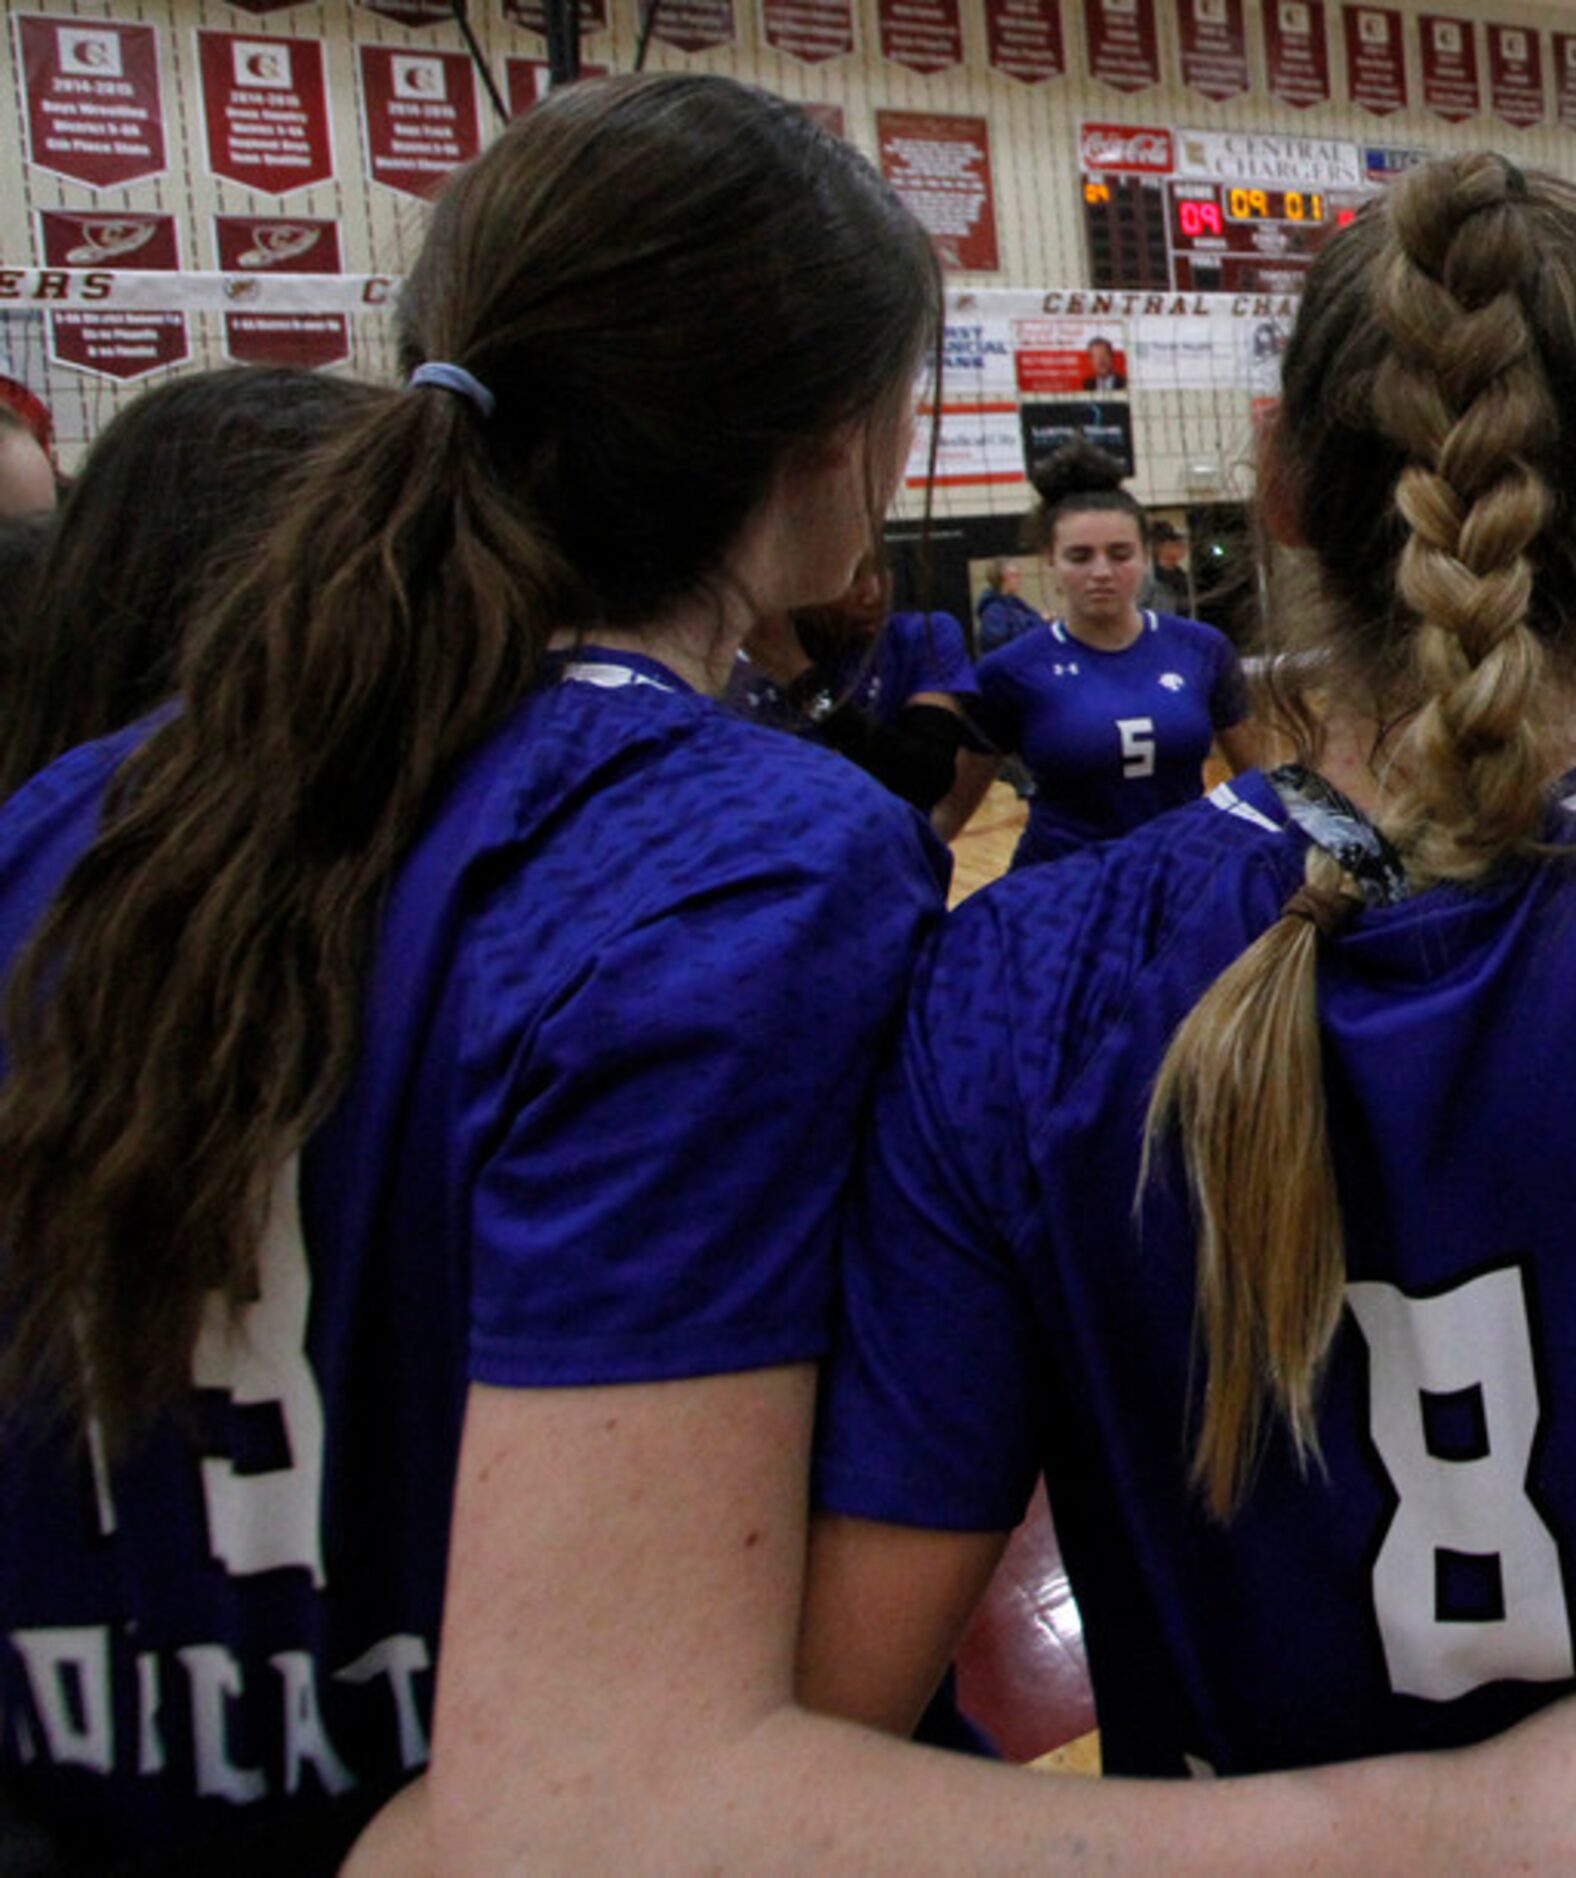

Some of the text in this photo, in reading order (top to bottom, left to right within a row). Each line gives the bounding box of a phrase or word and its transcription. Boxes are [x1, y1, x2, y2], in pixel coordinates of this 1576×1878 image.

[1225, 136, 1339, 162] CENTRAL
[1213, 155, 1356, 183] CHARGERS
[1180, 200, 1222, 237] 09
[1230, 188, 1323, 221] 09 01
[1042, 292, 1210, 315] CENTRAL
[1114, 716, 1156, 780] 5
[1344, 1263, 1576, 1702] 8
